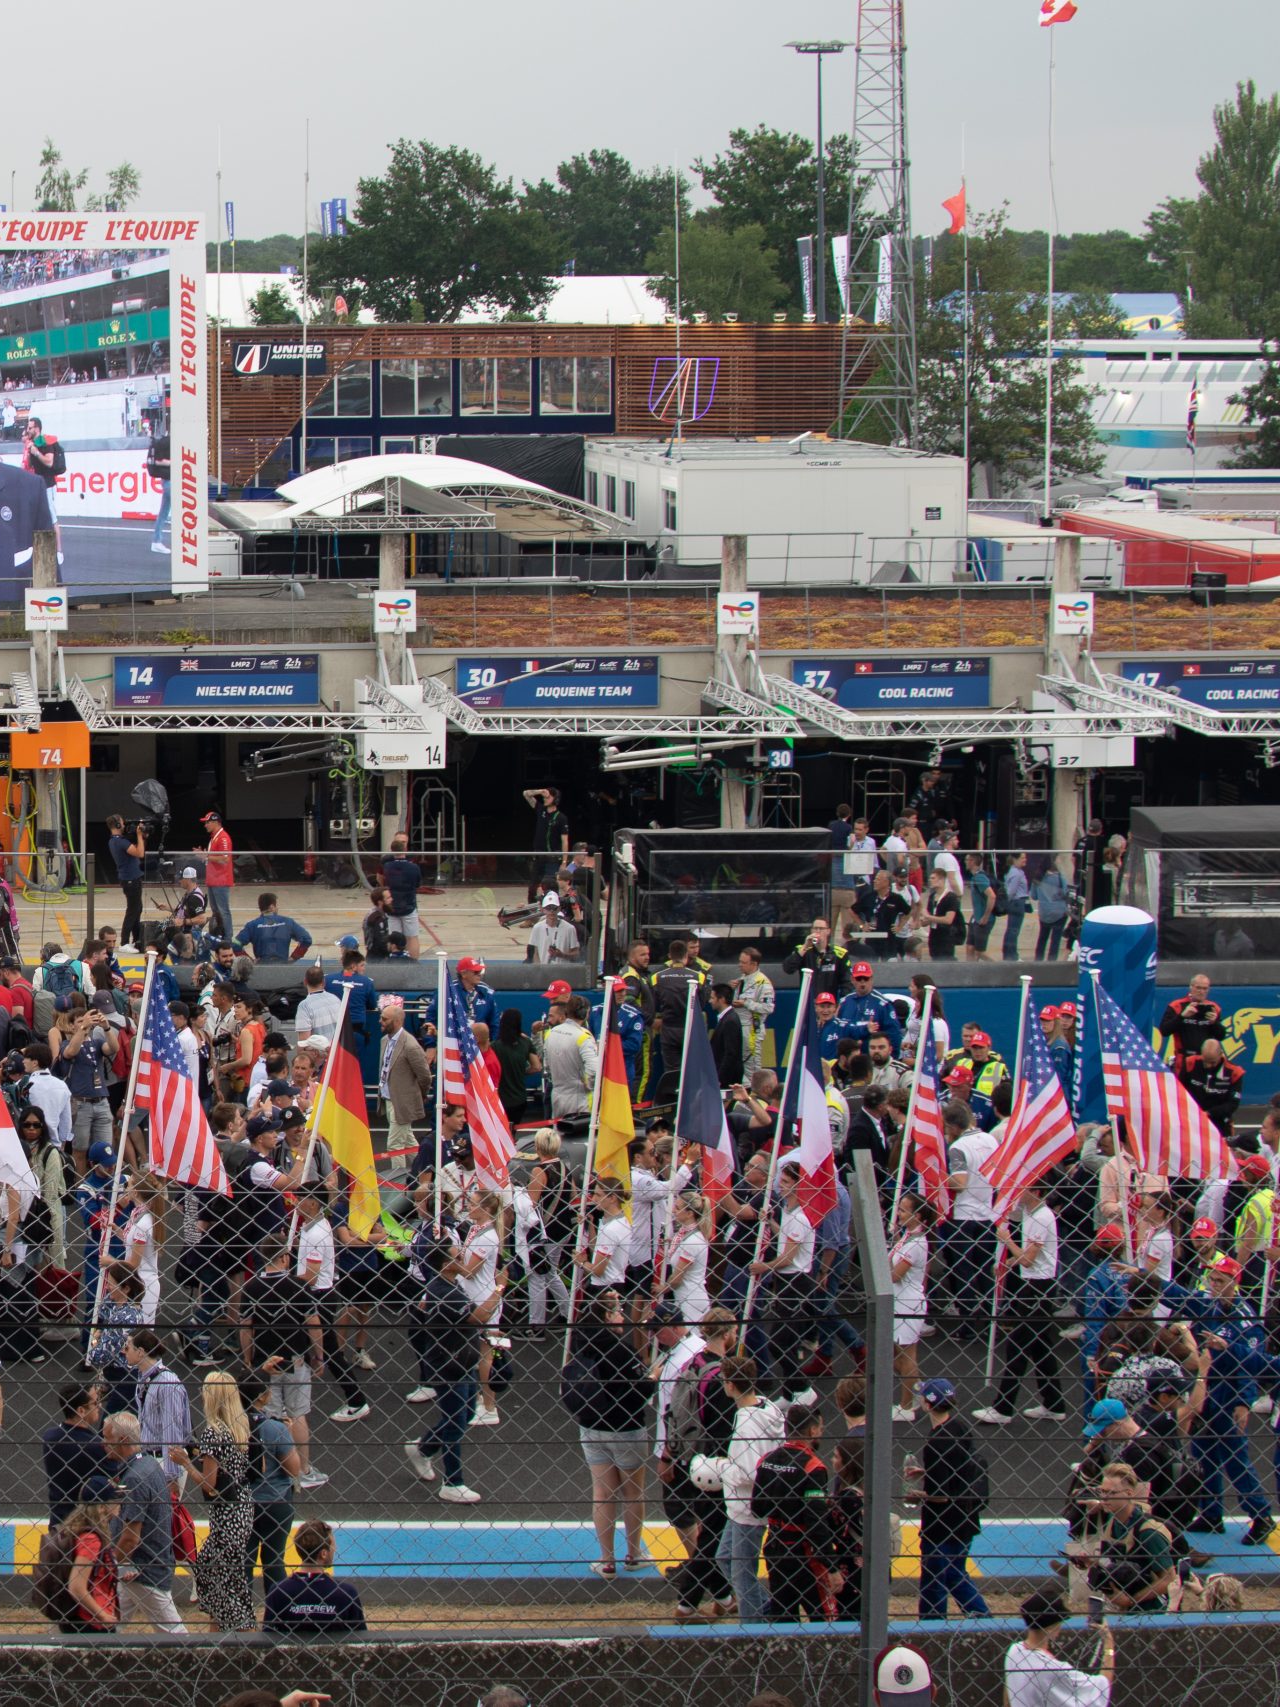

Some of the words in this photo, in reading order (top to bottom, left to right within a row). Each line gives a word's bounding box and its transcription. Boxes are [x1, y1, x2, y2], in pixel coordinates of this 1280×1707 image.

[98, 331, 137, 346] ROLEX
[6, 347, 38, 360] ROLEX
[272, 345, 324, 354] UNITED
[129, 667, 153, 685] 14
[467, 668, 496, 687] 30
[803, 671, 830, 688] 37
[196, 686, 247, 697] NIELSEN
[249, 685, 293, 696] RACING
[536, 686, 596, 698] DUQUEINE
[599, 686, 632, 697] TEAM
[879, 688, 908, 698] COOL
[910, 687, 953, 698] RACING
[1206, 690, 1234, 700] COOL
[1237, 689, 1279, 699] RACING
[41, 749, 62, 766] 74
[425, 745, 441, 764] 14
[771, 751, 791, 768] 30
[1058, 756, 1079, 765] 37
[1078, 946, 1104, 965] EC
